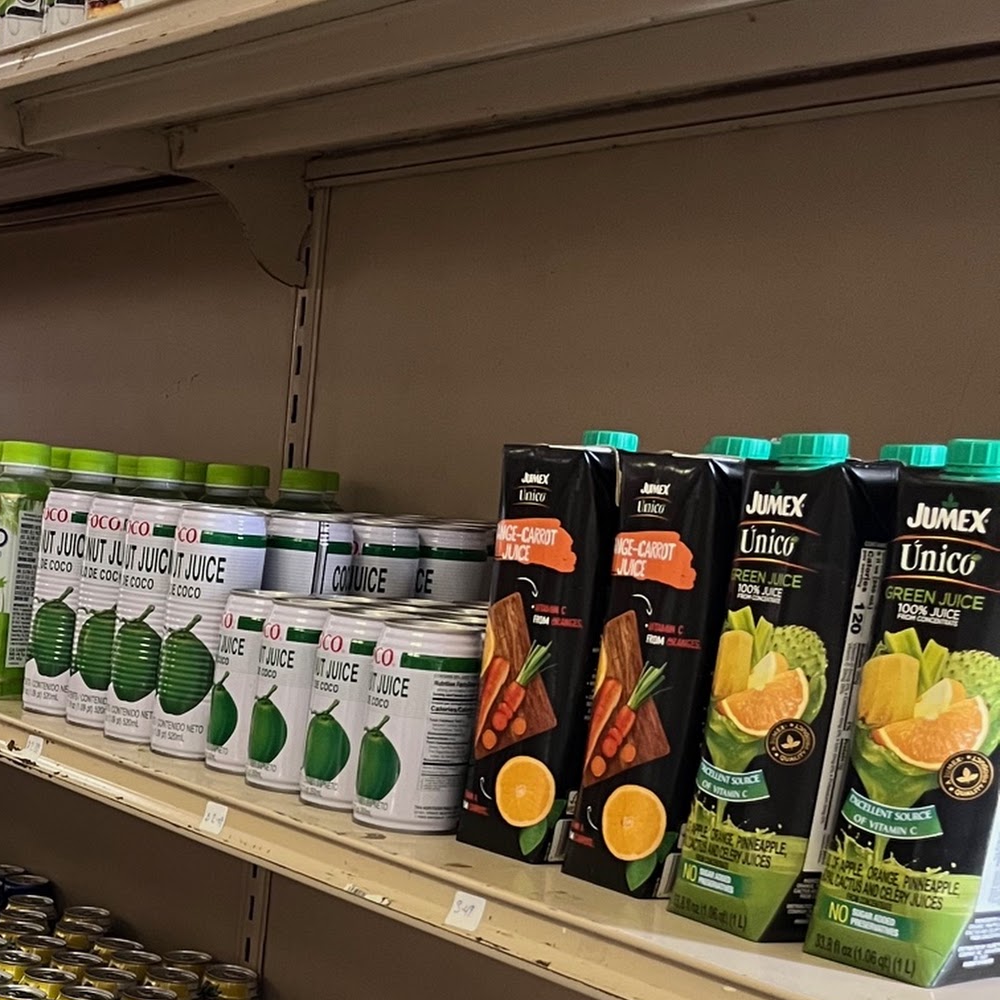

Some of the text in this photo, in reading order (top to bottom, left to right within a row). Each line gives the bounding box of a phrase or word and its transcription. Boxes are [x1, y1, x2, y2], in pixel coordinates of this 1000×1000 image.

[521, 472, 550, 486] JUMEX
[640, 482, 671, 496] JUMEX
[746, 491, 807, 518] JUMEX
[907, 503, 992, 534] JUMEX
[740, 526, 795, 557] Único
[501, 543, 531, 561] JUICE
[901, 540, 977, 576] Único
[50, 560, 73, 573] COCO
[185, 553, 227, 584] JUICE
[616, 559, 647, 577] JUICE
[130, 577, 154, 590] COCO
[768, 573, 803, 589] JUICE
[177, 585, 201, 599] COCO
[737, 583, 783, 598] 100% JUICE
[885, 585, 986, 611] GREEN JUICE
[851, 602, 866, 635] 120
[897, 603, 961, 621] 100% JUICE
[266, 647, 295, 669] JUICE
[327, 658, 360, 683] JUICE
[320, 681, 339, 693] COCO
[377, 673, 410, 698] JUICE
[731, 773, 761, 785] SOURCE
[713, 783, 740, 798] VITAMIN
[742, 789, 748, 798] C
[896, 808, 933, 821] SOURCE
[853, 813, 918, 835] OF VITAMIN C
[683, 863, 697, 882] NO
[911, 892, 943, 910] JUICES
[828, 901, 848, 923] NO
